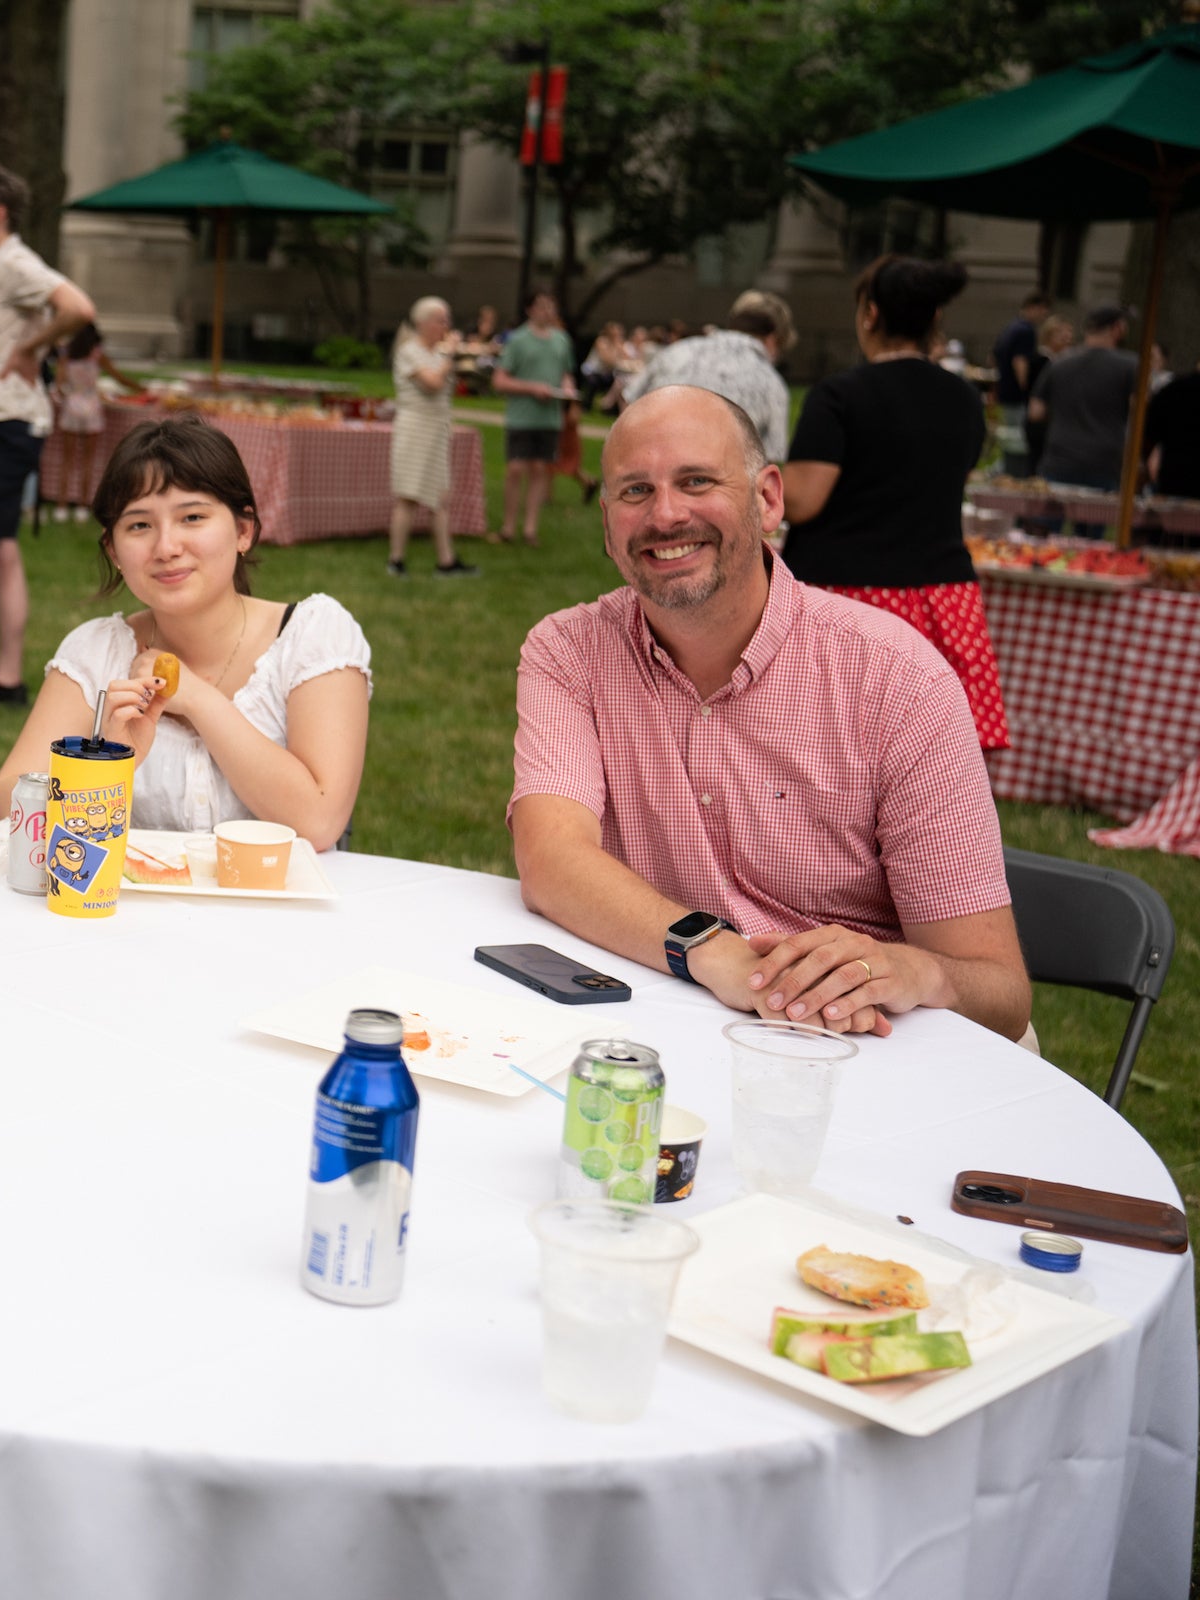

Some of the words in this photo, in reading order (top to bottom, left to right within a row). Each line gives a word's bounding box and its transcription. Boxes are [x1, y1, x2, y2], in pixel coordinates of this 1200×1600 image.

[62, 784, 124, 803] POSITIVE
[64, 804, 86, 813] VIBES
[83, 899, 119, 910] MINION
